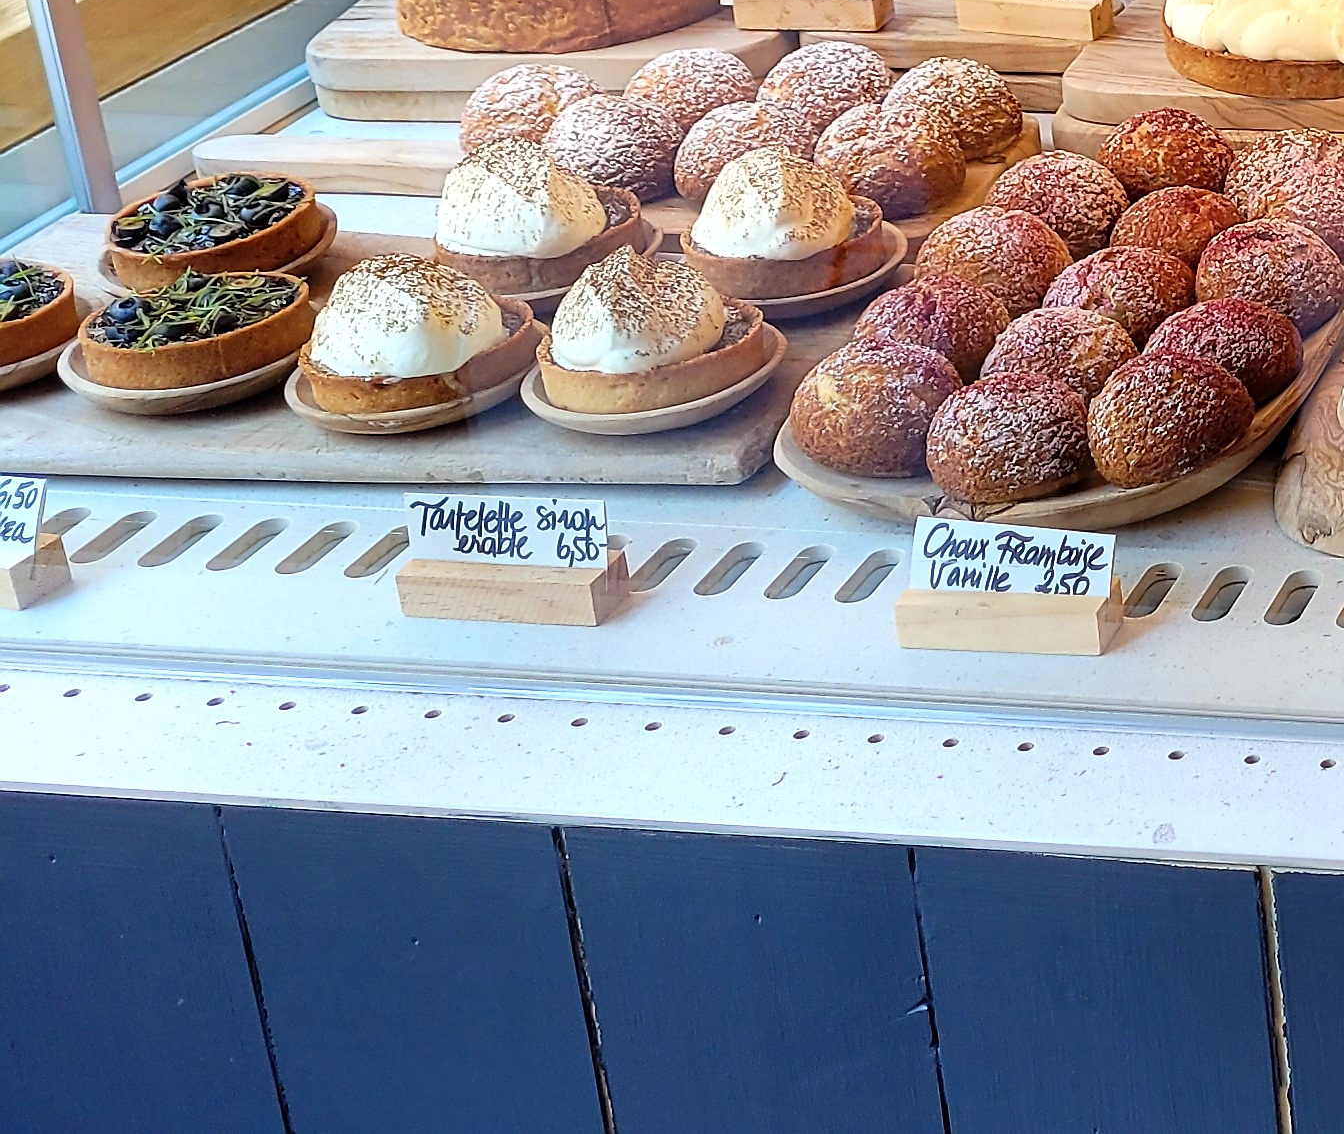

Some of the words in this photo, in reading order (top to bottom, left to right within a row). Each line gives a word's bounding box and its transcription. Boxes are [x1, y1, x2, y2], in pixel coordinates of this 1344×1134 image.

[409, 496, 528, 541] Tartelette
[923, 522, 990, 561] Choux
[994, 530, 1110, 578] Framboise
[929, 559, 1013, 593] Vanille
